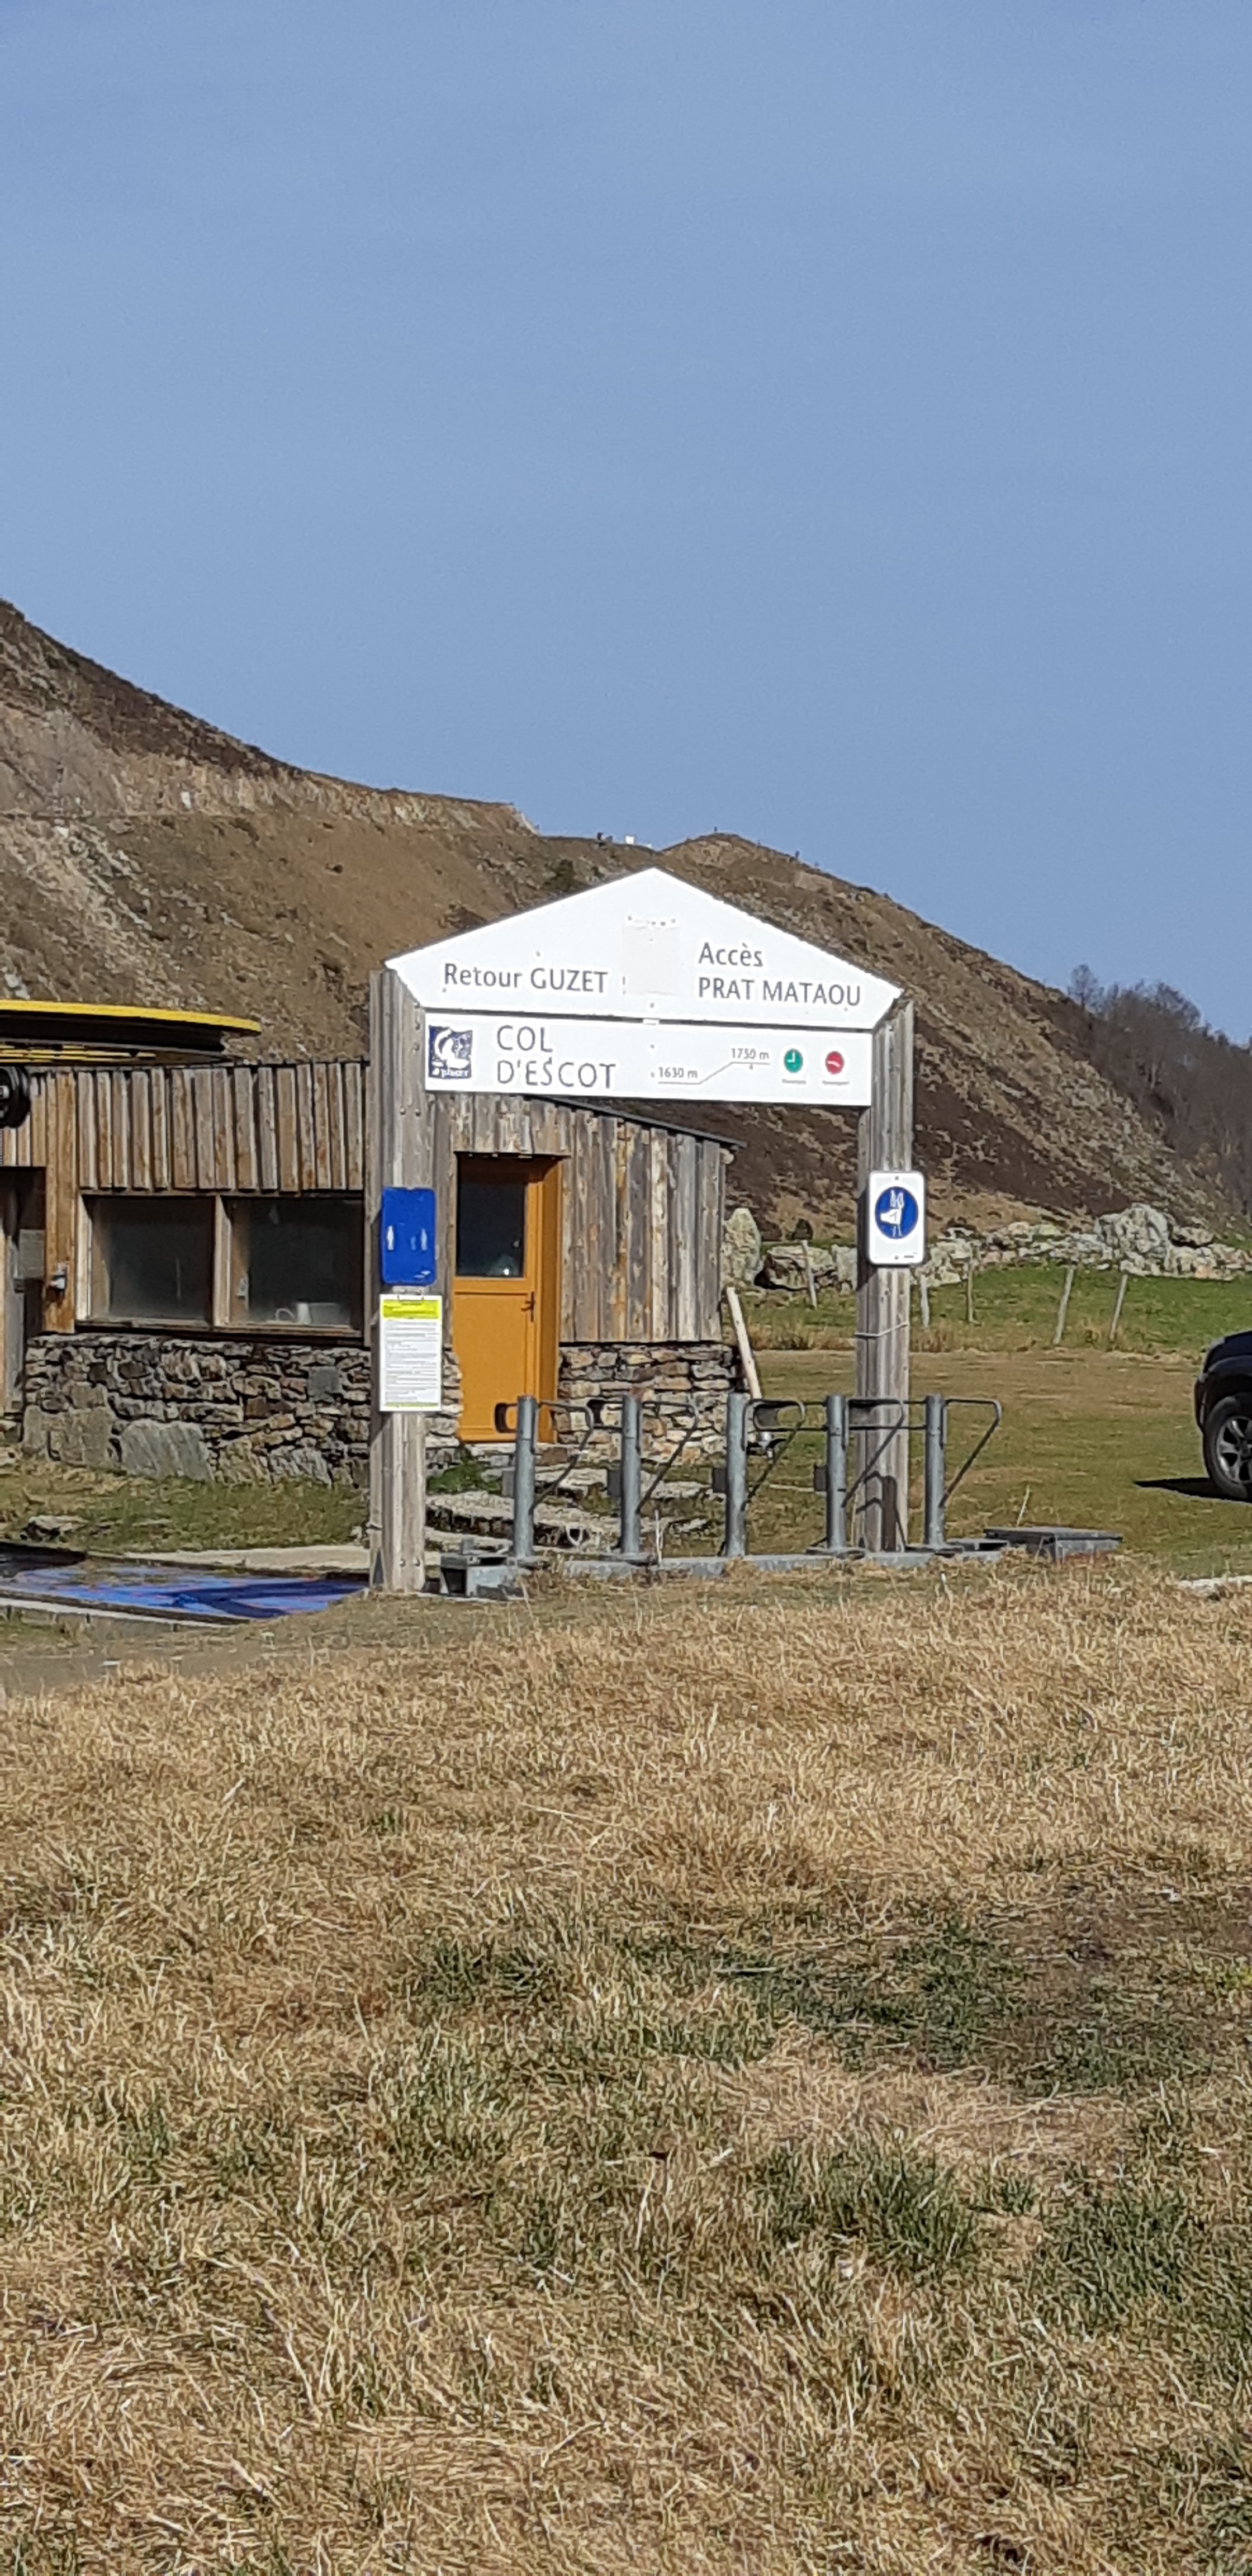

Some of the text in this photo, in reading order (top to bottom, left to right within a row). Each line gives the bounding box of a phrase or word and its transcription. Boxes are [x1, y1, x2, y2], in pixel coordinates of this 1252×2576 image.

[698, 942, 763, 967] Accès
[444, 962, 609, 993] Retour GUZET
[699, 977, 861, 1006] PRAT MATAOU
[497, 1025, 553, 1053] COL
[759, 1052, 770, 1060] m
[497, 1058, 616, 1089] D'ESCOT
[687, 1070, 698, 1079] m
